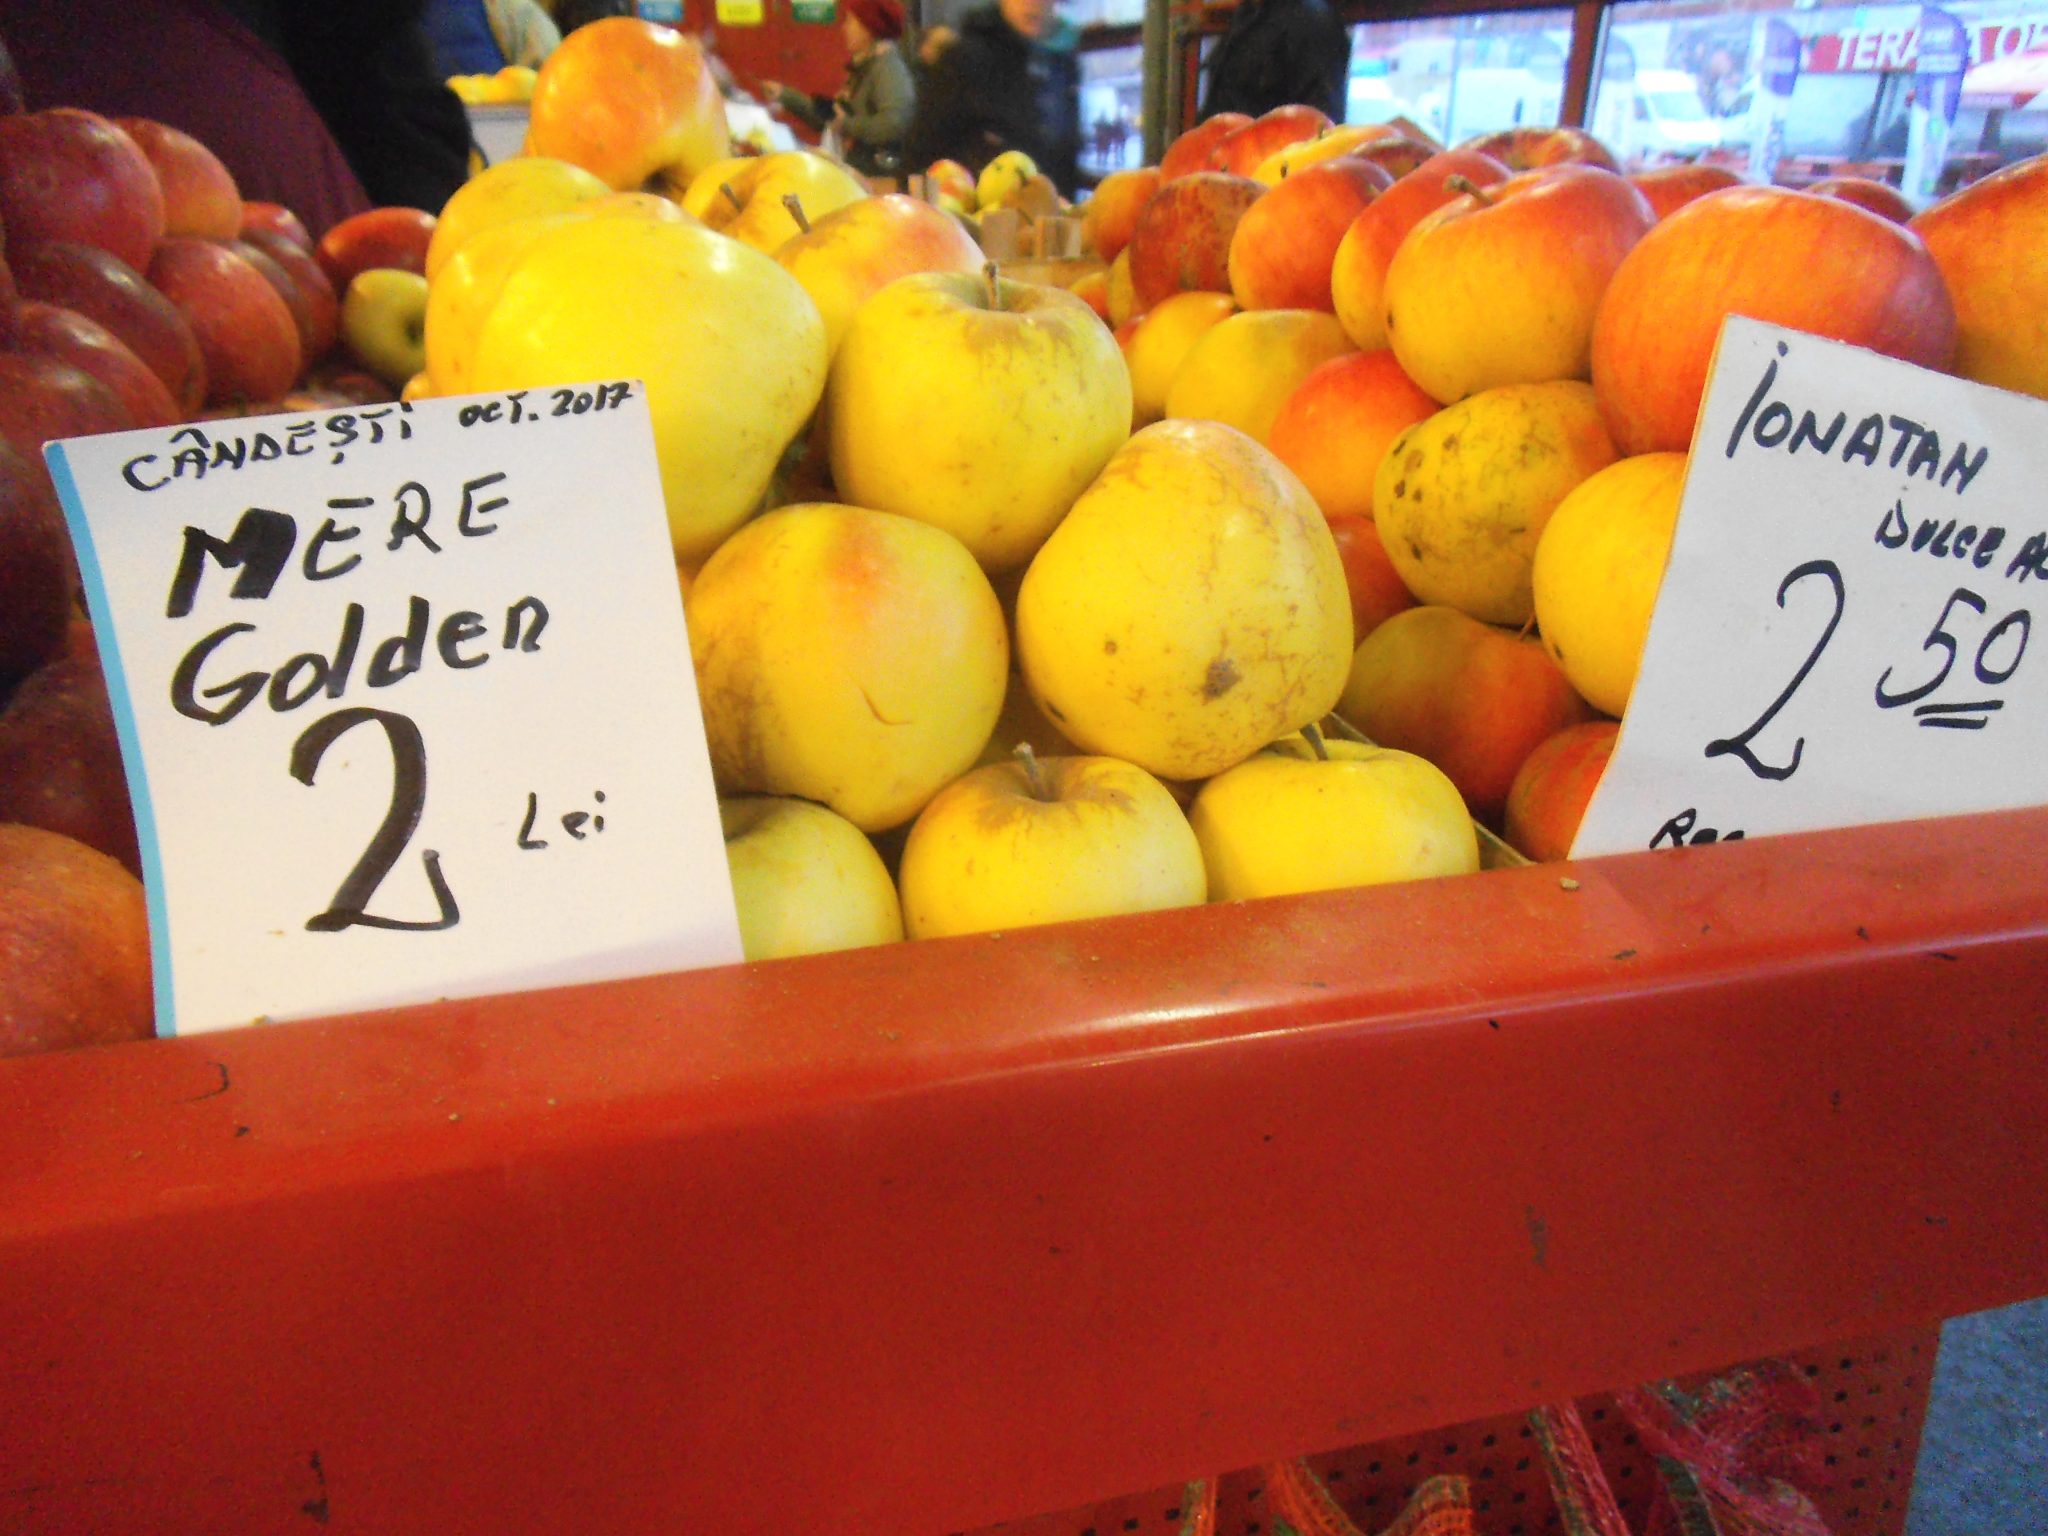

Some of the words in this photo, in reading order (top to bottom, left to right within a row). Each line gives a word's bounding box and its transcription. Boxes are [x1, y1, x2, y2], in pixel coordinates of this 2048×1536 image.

[550, 381, 634, 417] 2017
[169, 594, 549, 725] Golden
[1704, 559, 1846, 780] 2
[1874, 587, 2032, 710] 50
[290, 706, 461, 932] 2
[517, 789, 607, 850] Lei
